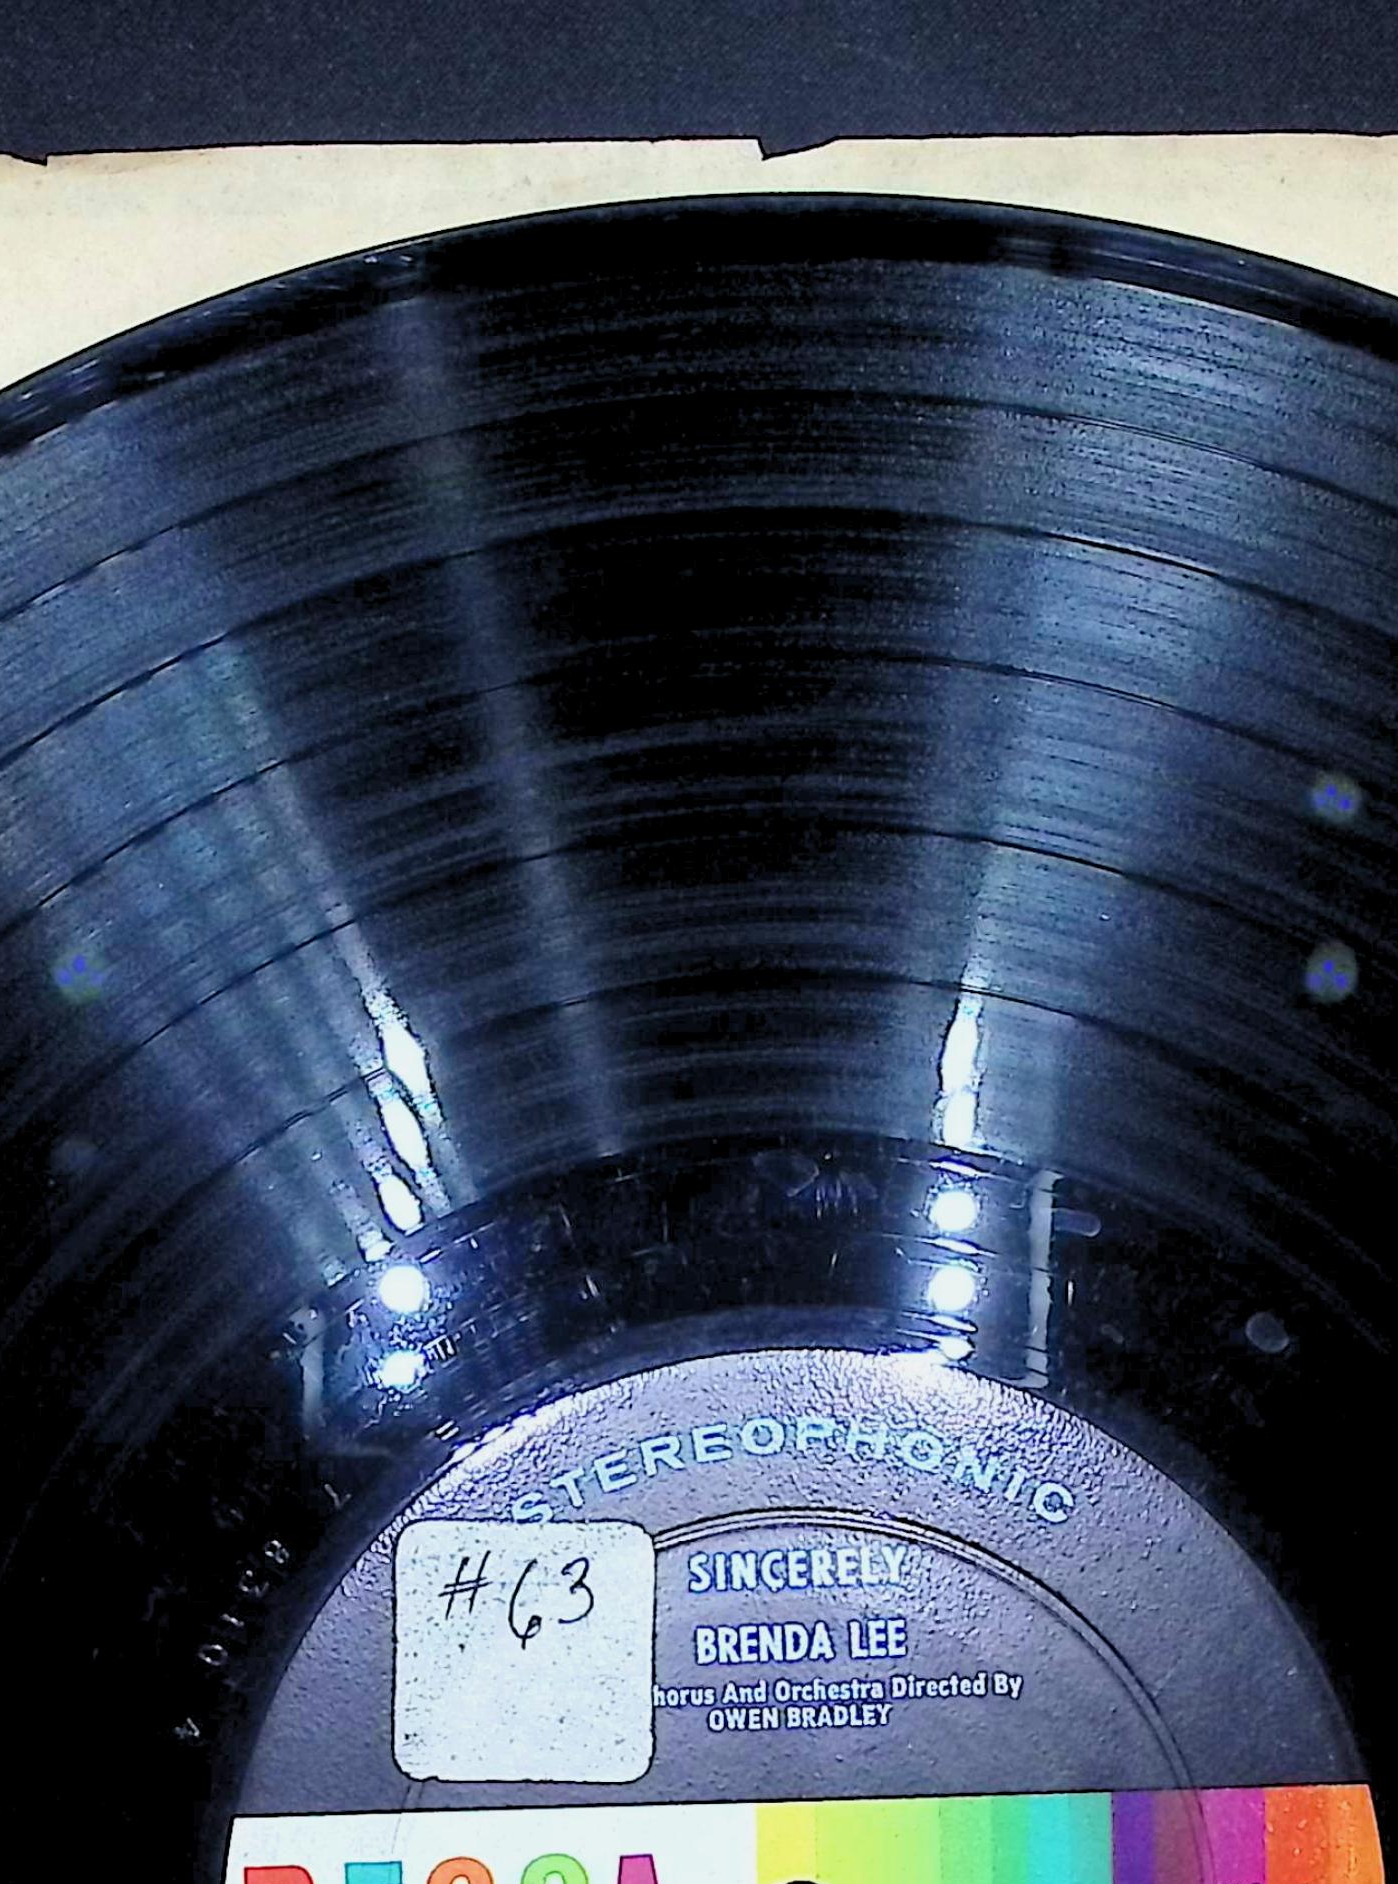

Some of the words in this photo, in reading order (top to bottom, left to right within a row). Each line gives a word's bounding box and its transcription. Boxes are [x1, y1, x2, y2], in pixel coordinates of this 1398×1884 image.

[511, 1415, 1075, 1524] STEREOPHONIC
[688, 1545, 908, 1593] SINCERELY
[695, 1621, 836, 1665] BRENDA
[849, 1618, 908, 1660] LEE
[653, 1685, 714, 1707] horus
[723, 1681, 766, 1705] And
[773, 1677, 883, 1703] Orchestra
[891, 1673, 987, 1699] Directed
[993, 1674, 1024, 1700] By
[709, 1707, 780, 1732] OWEN
[786, 1703, 892, 1728] BRADLEY
